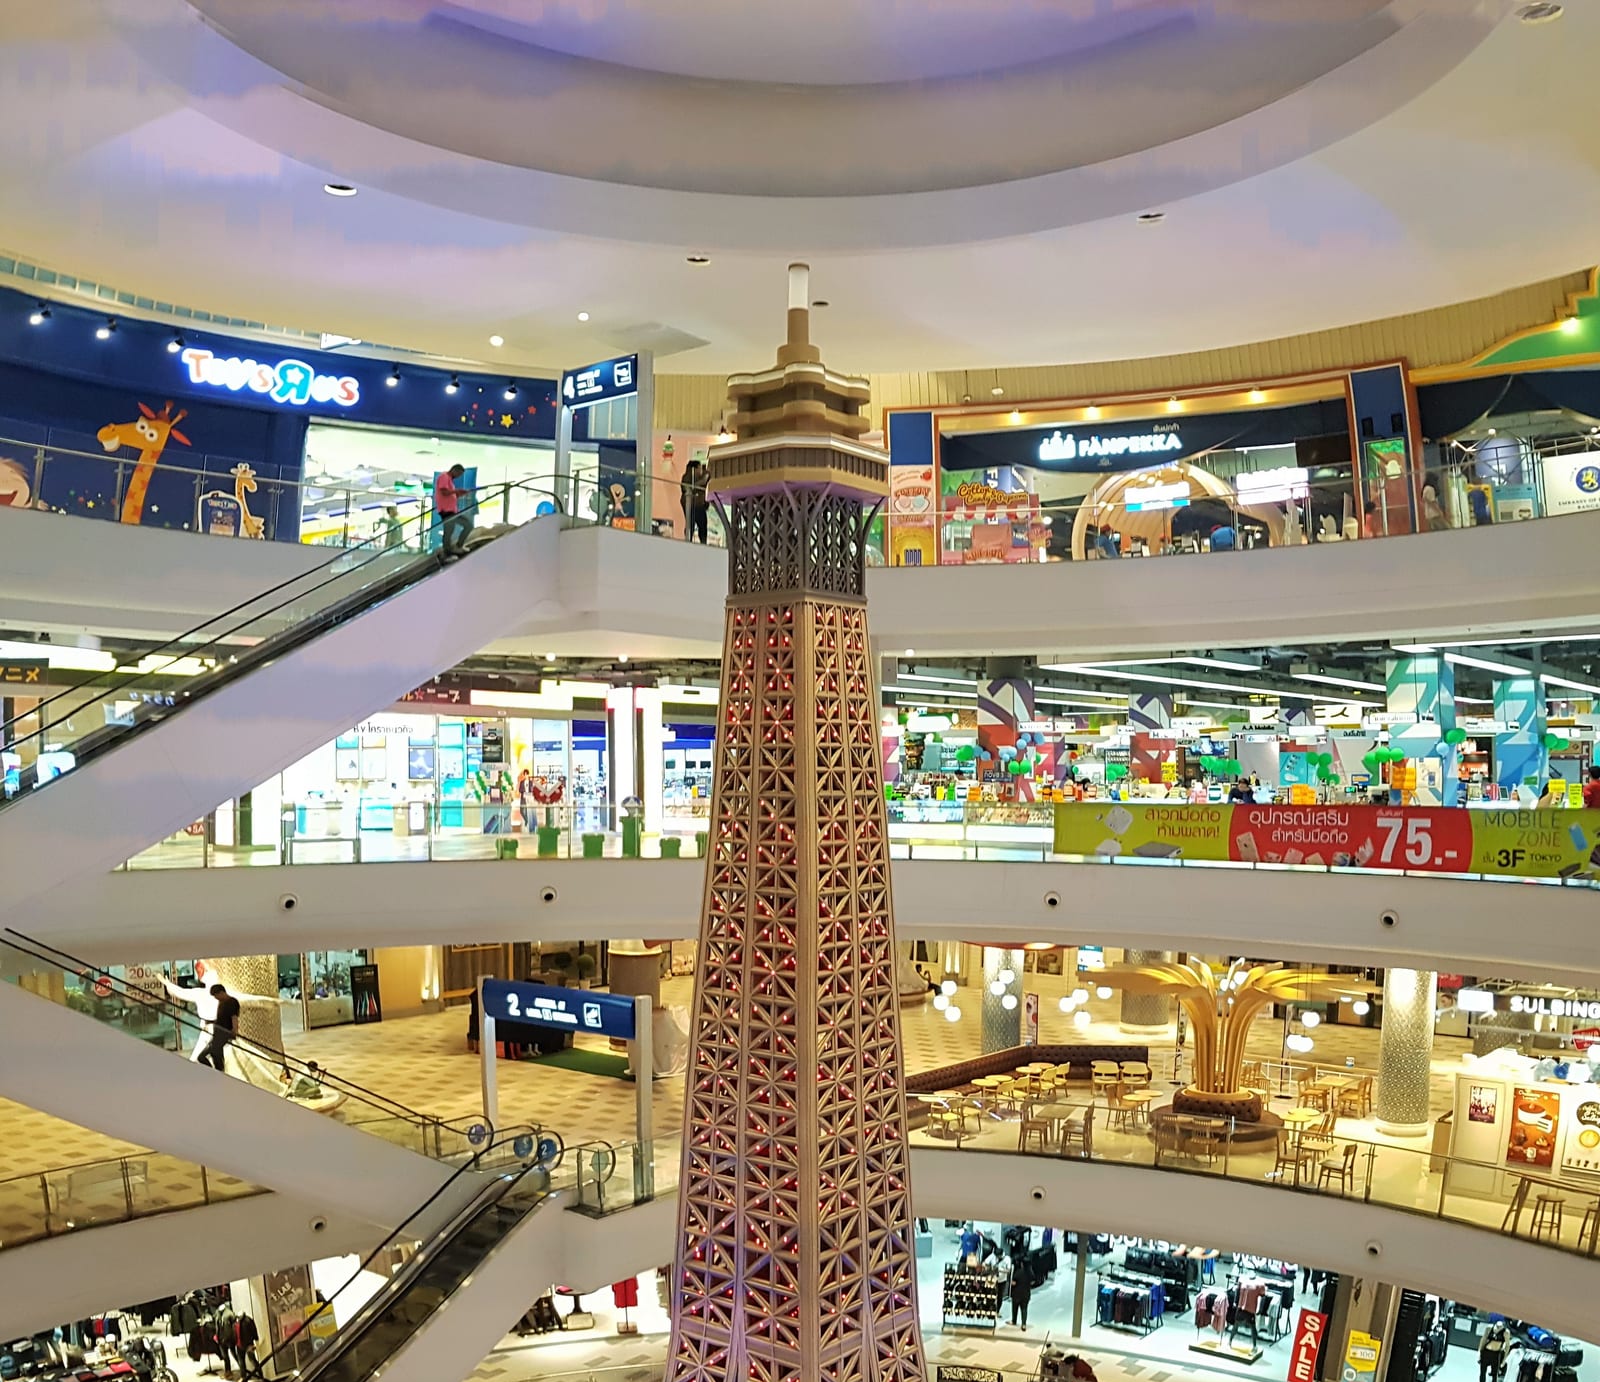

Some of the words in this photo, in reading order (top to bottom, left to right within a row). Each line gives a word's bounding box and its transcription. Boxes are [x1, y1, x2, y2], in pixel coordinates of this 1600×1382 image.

[563, 375, 575, 399] 4
[1249, 808, 1349, 828] อุปกรณ์เสริม
[1484, 809, 1562, 829] MOBILE
[1271, 829, 1349, 844] สำหรับมือถือ
[1516, 830, 1561, 847] ZONE
[1497, 850, 1526, 868] 3F
[1529, 854, 1562, 863] TOKYO
[507, 993, 521, 1017] 2
[541, 1144, 548, 1156] 2
[1295, 1315, 1321, 1381] SALE
